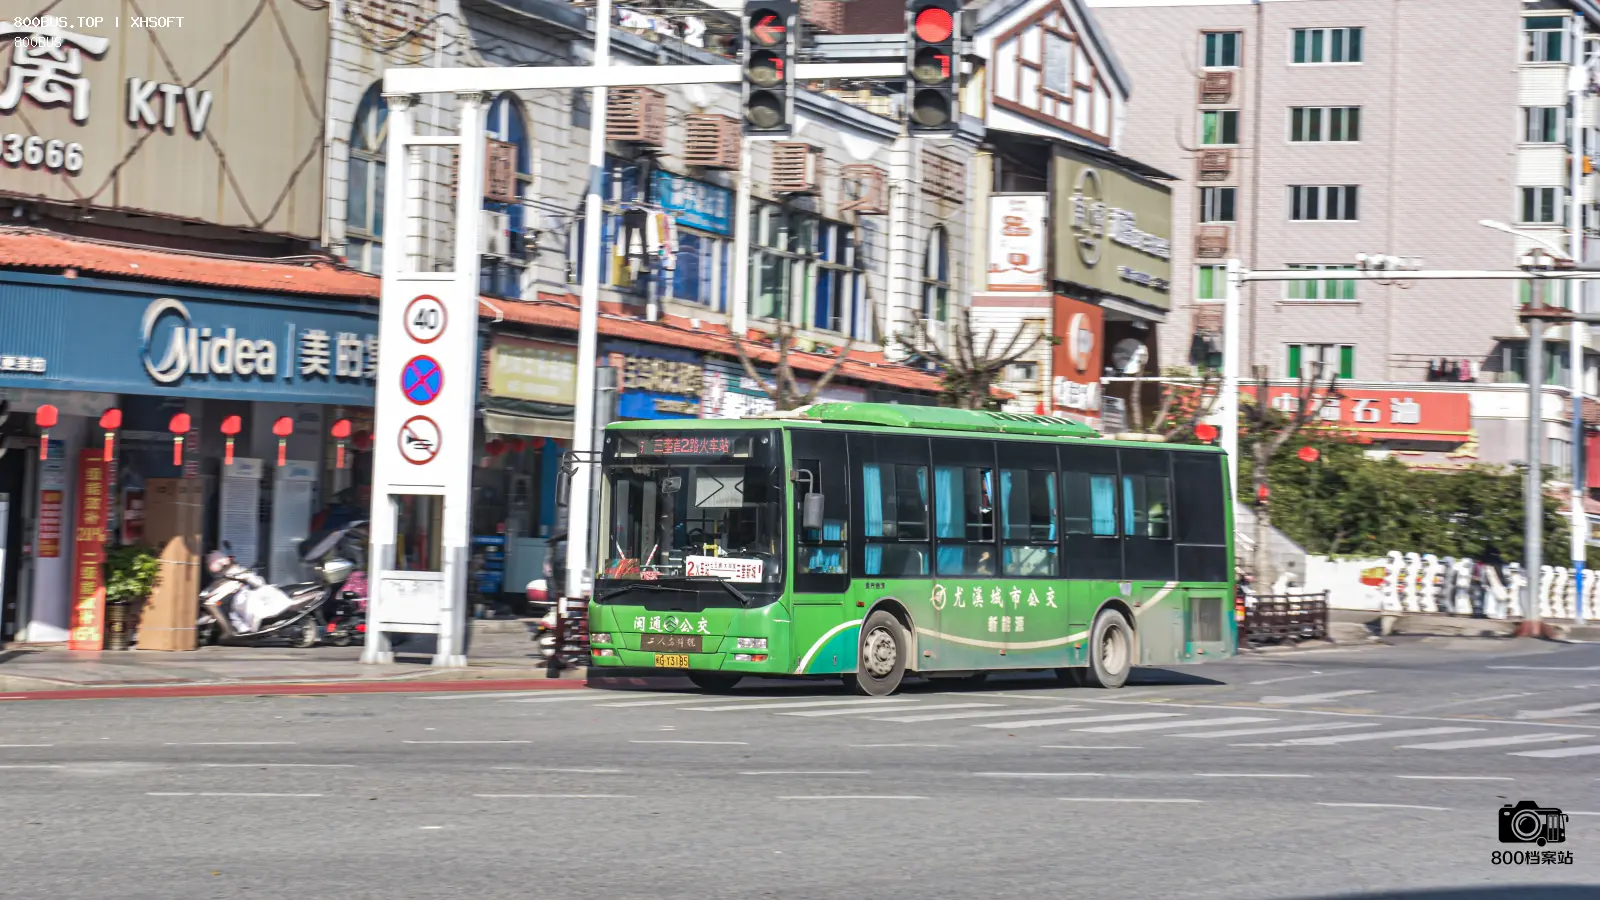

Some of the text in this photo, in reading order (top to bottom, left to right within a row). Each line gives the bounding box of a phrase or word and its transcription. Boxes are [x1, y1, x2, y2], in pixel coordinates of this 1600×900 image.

[128, 77, 212, 133] KTV
[0, 133, 84, 171] 3666
[413, 308, 439, 329] 40
[142, 298, 277, 382] Midea
[953, 585, 1058, 610] 尤溪城市公交
[633, 616, 711, 635] 闽通 公交
